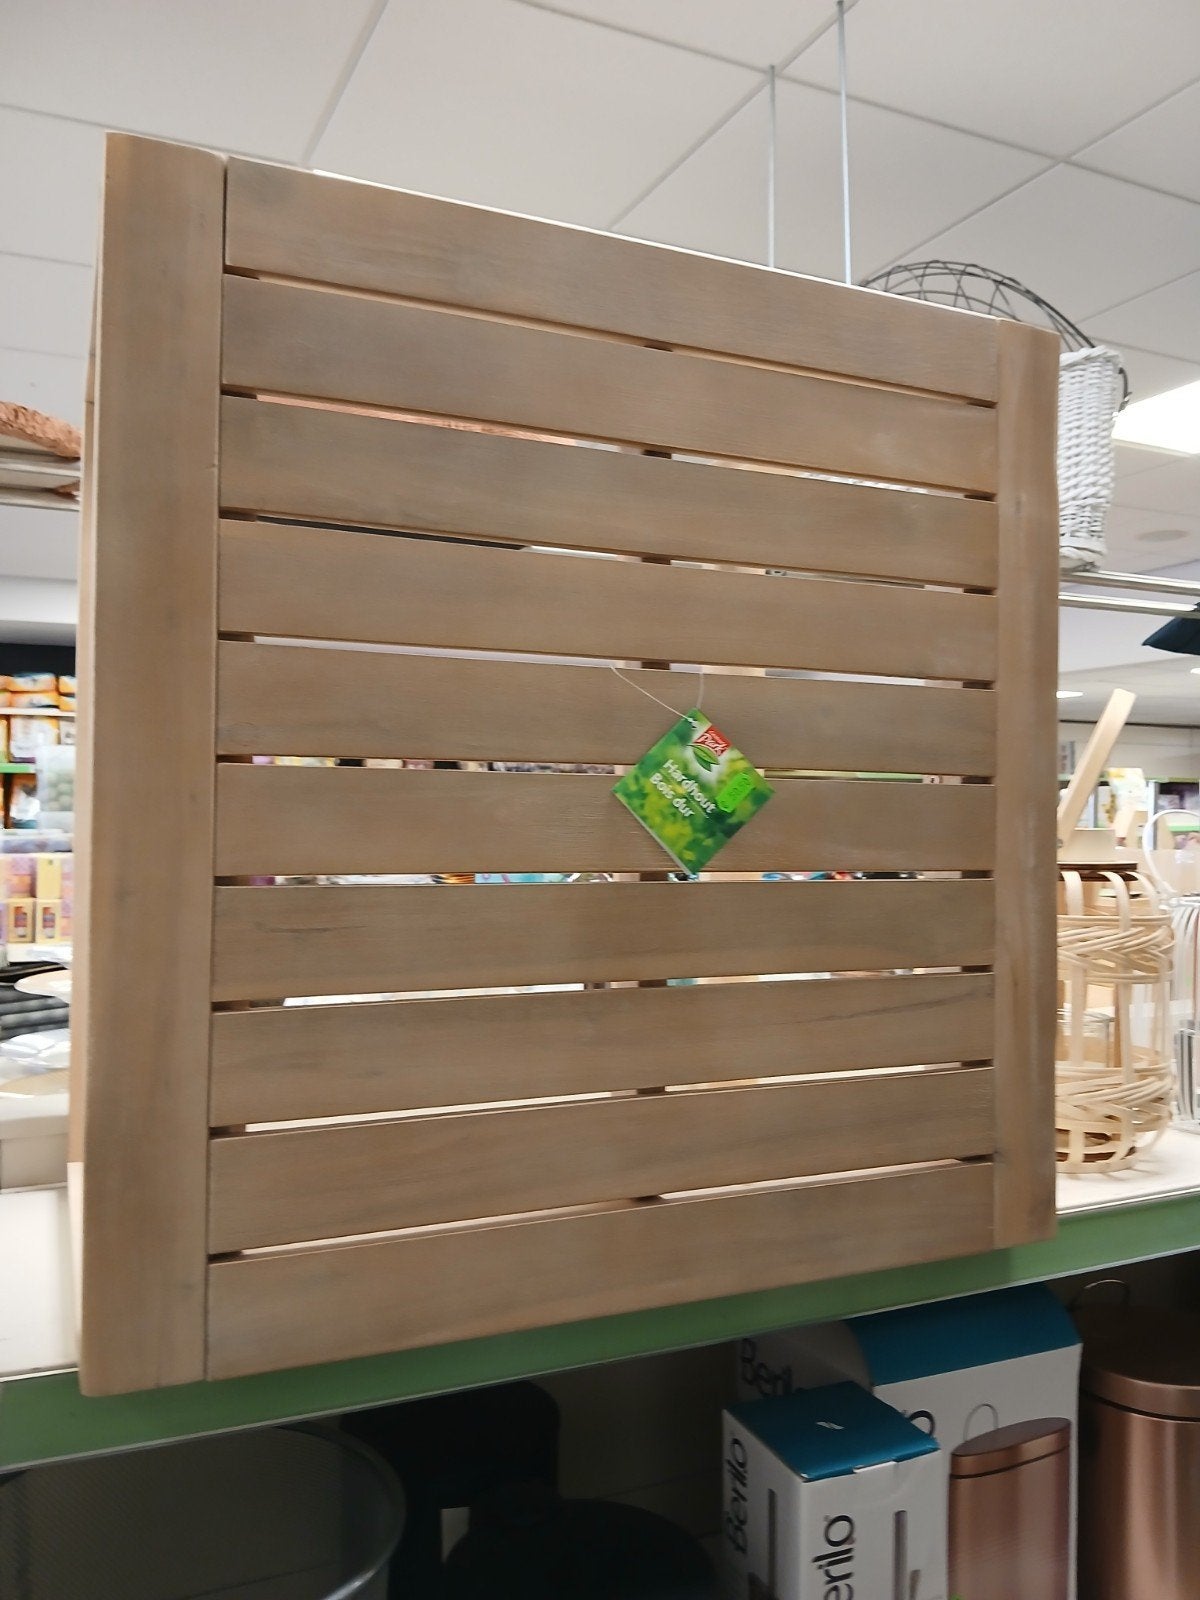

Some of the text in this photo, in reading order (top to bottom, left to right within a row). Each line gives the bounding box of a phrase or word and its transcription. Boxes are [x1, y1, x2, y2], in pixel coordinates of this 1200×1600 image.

[650, 772, 695, 817] Bois dur
[663, 759, 716, 814] Hardhout
